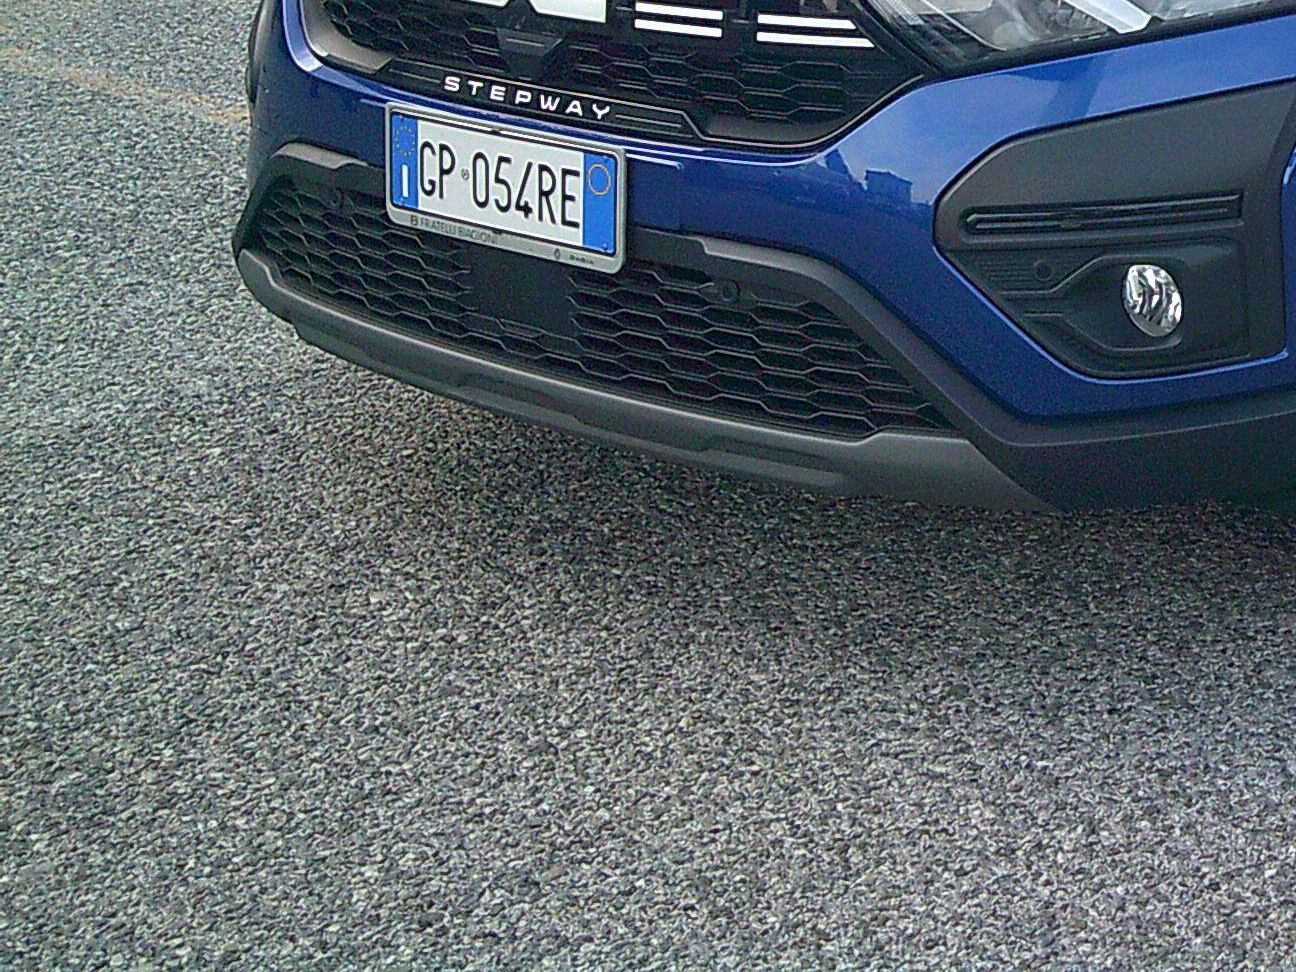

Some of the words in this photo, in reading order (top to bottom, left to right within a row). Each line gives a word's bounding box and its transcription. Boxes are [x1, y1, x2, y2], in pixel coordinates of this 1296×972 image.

[444, 76, 610, 119] STEPWAY
[419, 141, 456, 199] GP
[472, 151, 580, 229] 054RE
